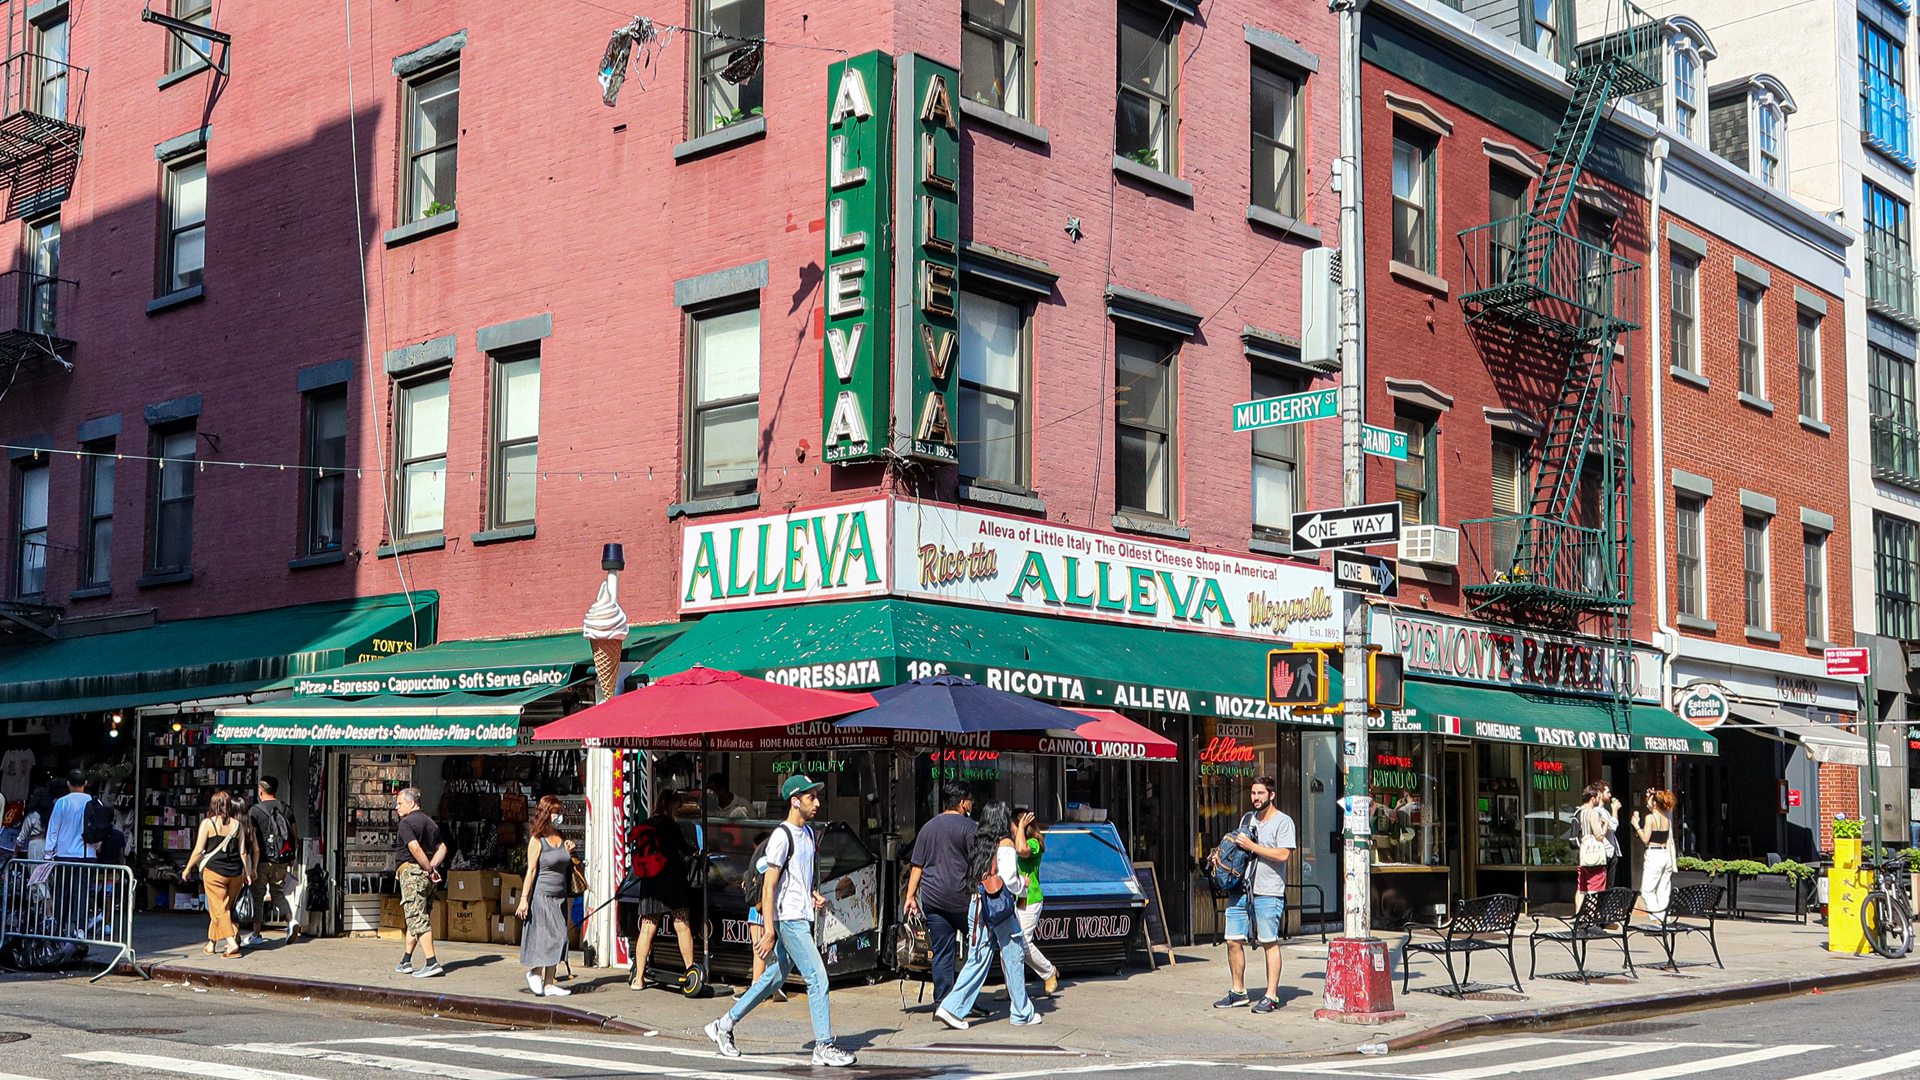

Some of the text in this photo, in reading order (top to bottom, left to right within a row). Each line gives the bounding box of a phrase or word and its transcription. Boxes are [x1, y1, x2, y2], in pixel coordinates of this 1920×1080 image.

[825, 67, 874, 446] ALLEVA
[917, 73, 957, 445] ALLEVA
[1237, 392, 1336, 429] MULBERRY ST
[915, 440, 955, 459] EST. 1892
[1362, 426, 1405, 455] GRAND ST
[826, 443, 869, 460] EST. 1892
[1308, 515, 1386, 539] ONE WAY
[684, 510, 883, 602] ALLEVA
[978, 519, 1278, 581] Alleva of Little Italy The Oldest Cheese Shop in America!
[918, 541, 999, 587] Ricotta
[1343, 563, 1389, 585] ONE WAY
[1006, 550, 1236, 628] ALLEVA
[1309, 625, 1341, 640] Est. 1892
[372, 638, 413, 654] TONY'S
[1395, 617, 1515, 680] PIEMONTE
[1522, 637, 1605, 691] RAVIOLI
[1836, 650, 1863, 658] STANDING
[1827, 657, 1850, 665] Anytime
[299, 669, 563, 696] Pizza Espresso Cappuccino Soft Serve Gelato
[765, 660, 881, 689] SOPRESSATA
[986, 668, 1085, 701] RICOTTA
[1114, 684, 1191, 712] ALLEVA
[1391, 709, 1417, 717] ELLINI
[1687, 699, 1721, 709] Estrella
[1688, 707, 1719, 717] Galicia
[216, 724, 253, 741] Espresso
[255, 723, 308, 741] Cappuccino
[310, 724, 342, 740] Coffee
[344, 724, 389, 740] Desserts
[392, 723, 444, 740] Smoothies
[447, 724, 471, 740] Pina
[475, 723, 513, 740] Colada
[786, 722, 864, 736] GELATO KING
[1218, 724, 1254, 737] RICOTTA
[1392, 722, 1422, 731] ELLONI
[584, 736, 621, 747] GELATO
[623, 736, 650, 747] KING
[652, 737, 670, 747] Home
[670, 737, 688, 747] Made
[688, 737, 708, 747] Gela
[716, 738, 738, 749] Italian
[738, 739, 754, 749] Ices
[759, 738, 782, 748] HOME
[783, 738, 804, 748] MADE
[805, 736, 833, 748] GELATO
[872, 736, 889, 745] ICES
[892, 729, 991, 748] annoli World
[1475, 720, 1714, 754] HOMEMADE TASTE OF ITALY FRESH PASTA 190
[1038, 737, 1147, 758] CANNOLI WORLD
[772, 762, 798, 774] BEST
[931, 767, 956, 780] BST
[1200, 764, 1256, 778] BEST QUALITY
[722, 918, 753, 944] KI
[1034, 914, 1131, 941] NOLI WORLD
